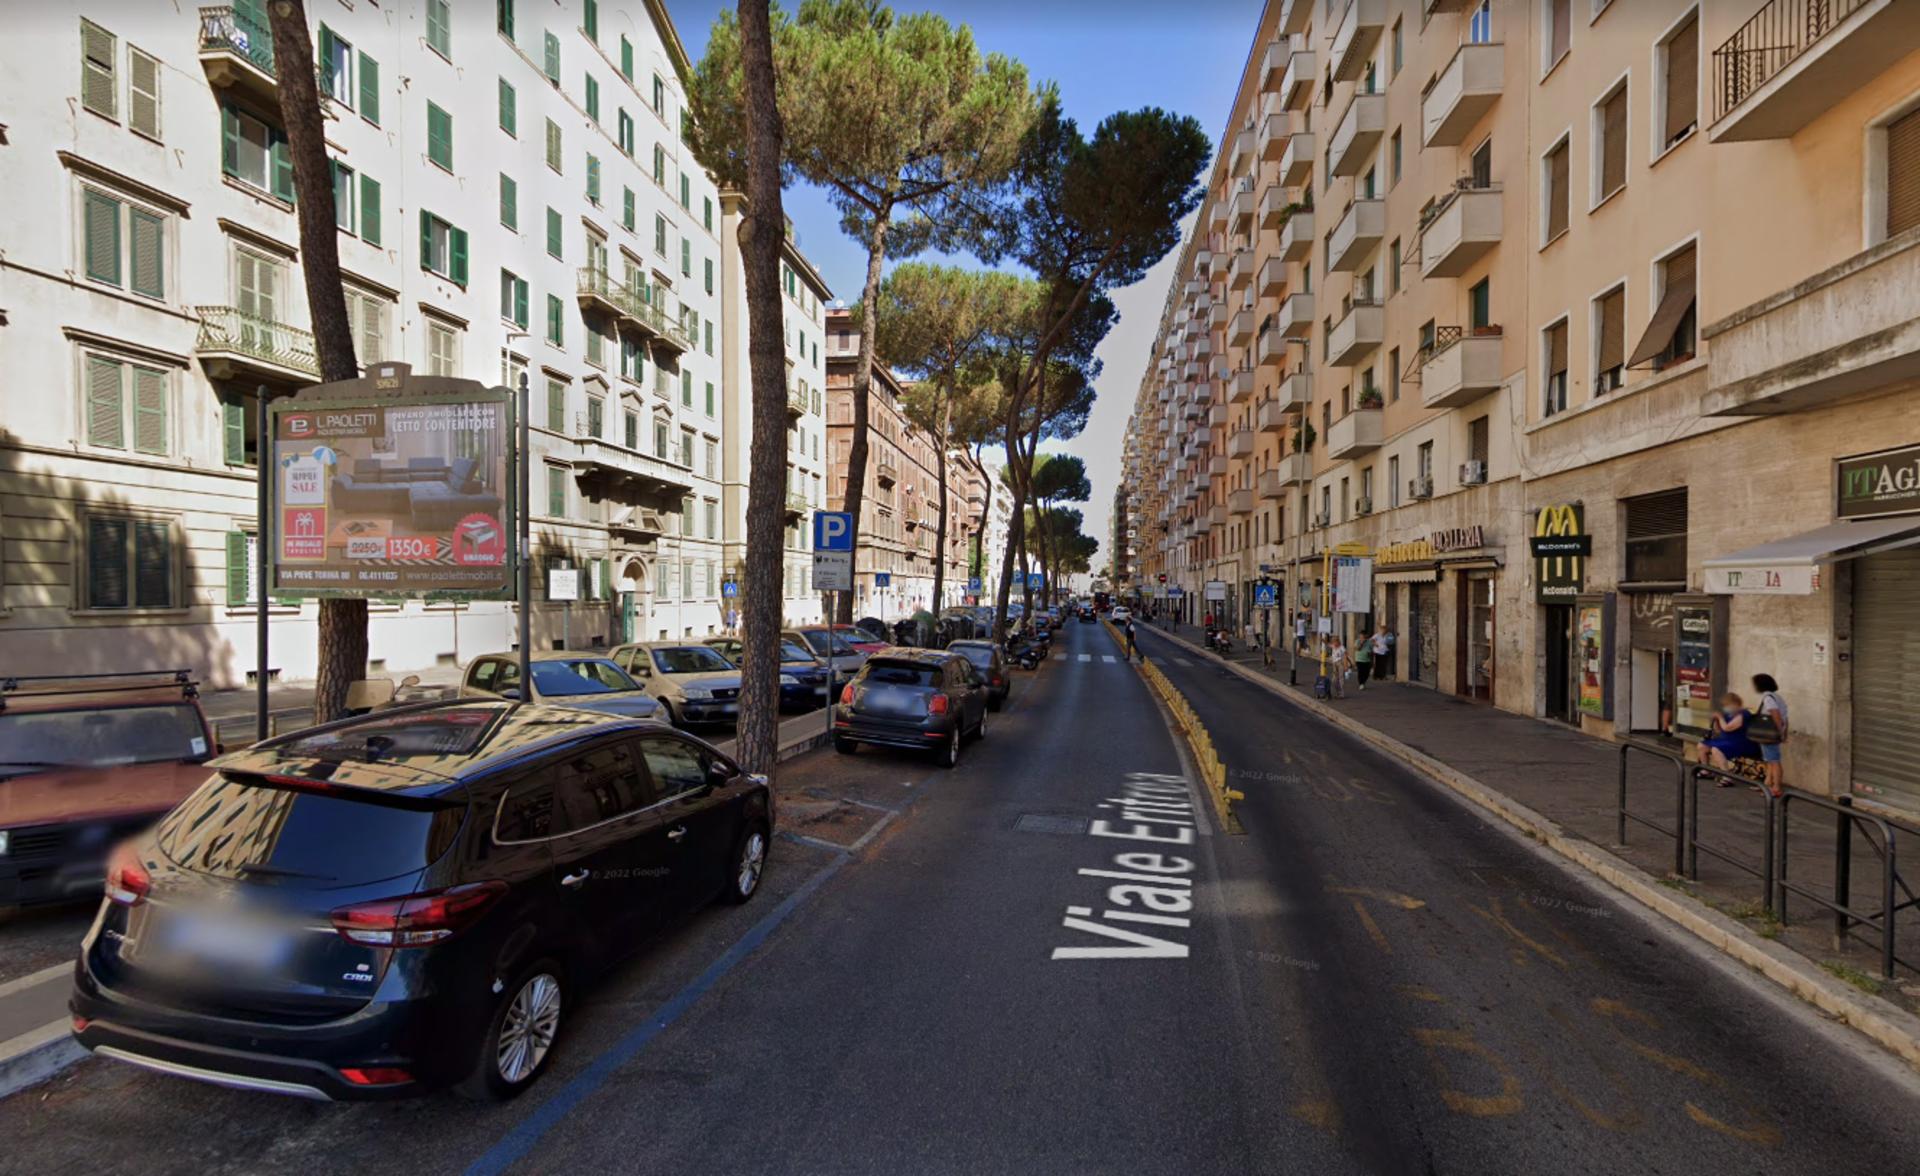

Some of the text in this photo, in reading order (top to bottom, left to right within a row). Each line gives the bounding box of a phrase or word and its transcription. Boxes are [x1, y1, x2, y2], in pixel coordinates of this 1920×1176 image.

[392, 417, 496, 432] LETTO CONTENITORE
[291, 481, 318, 493] SALE
[822, 515, 846, 547] P
[1538, 542, 1580, 550] McDonald's
[281, 570, 292, 580] VIA
